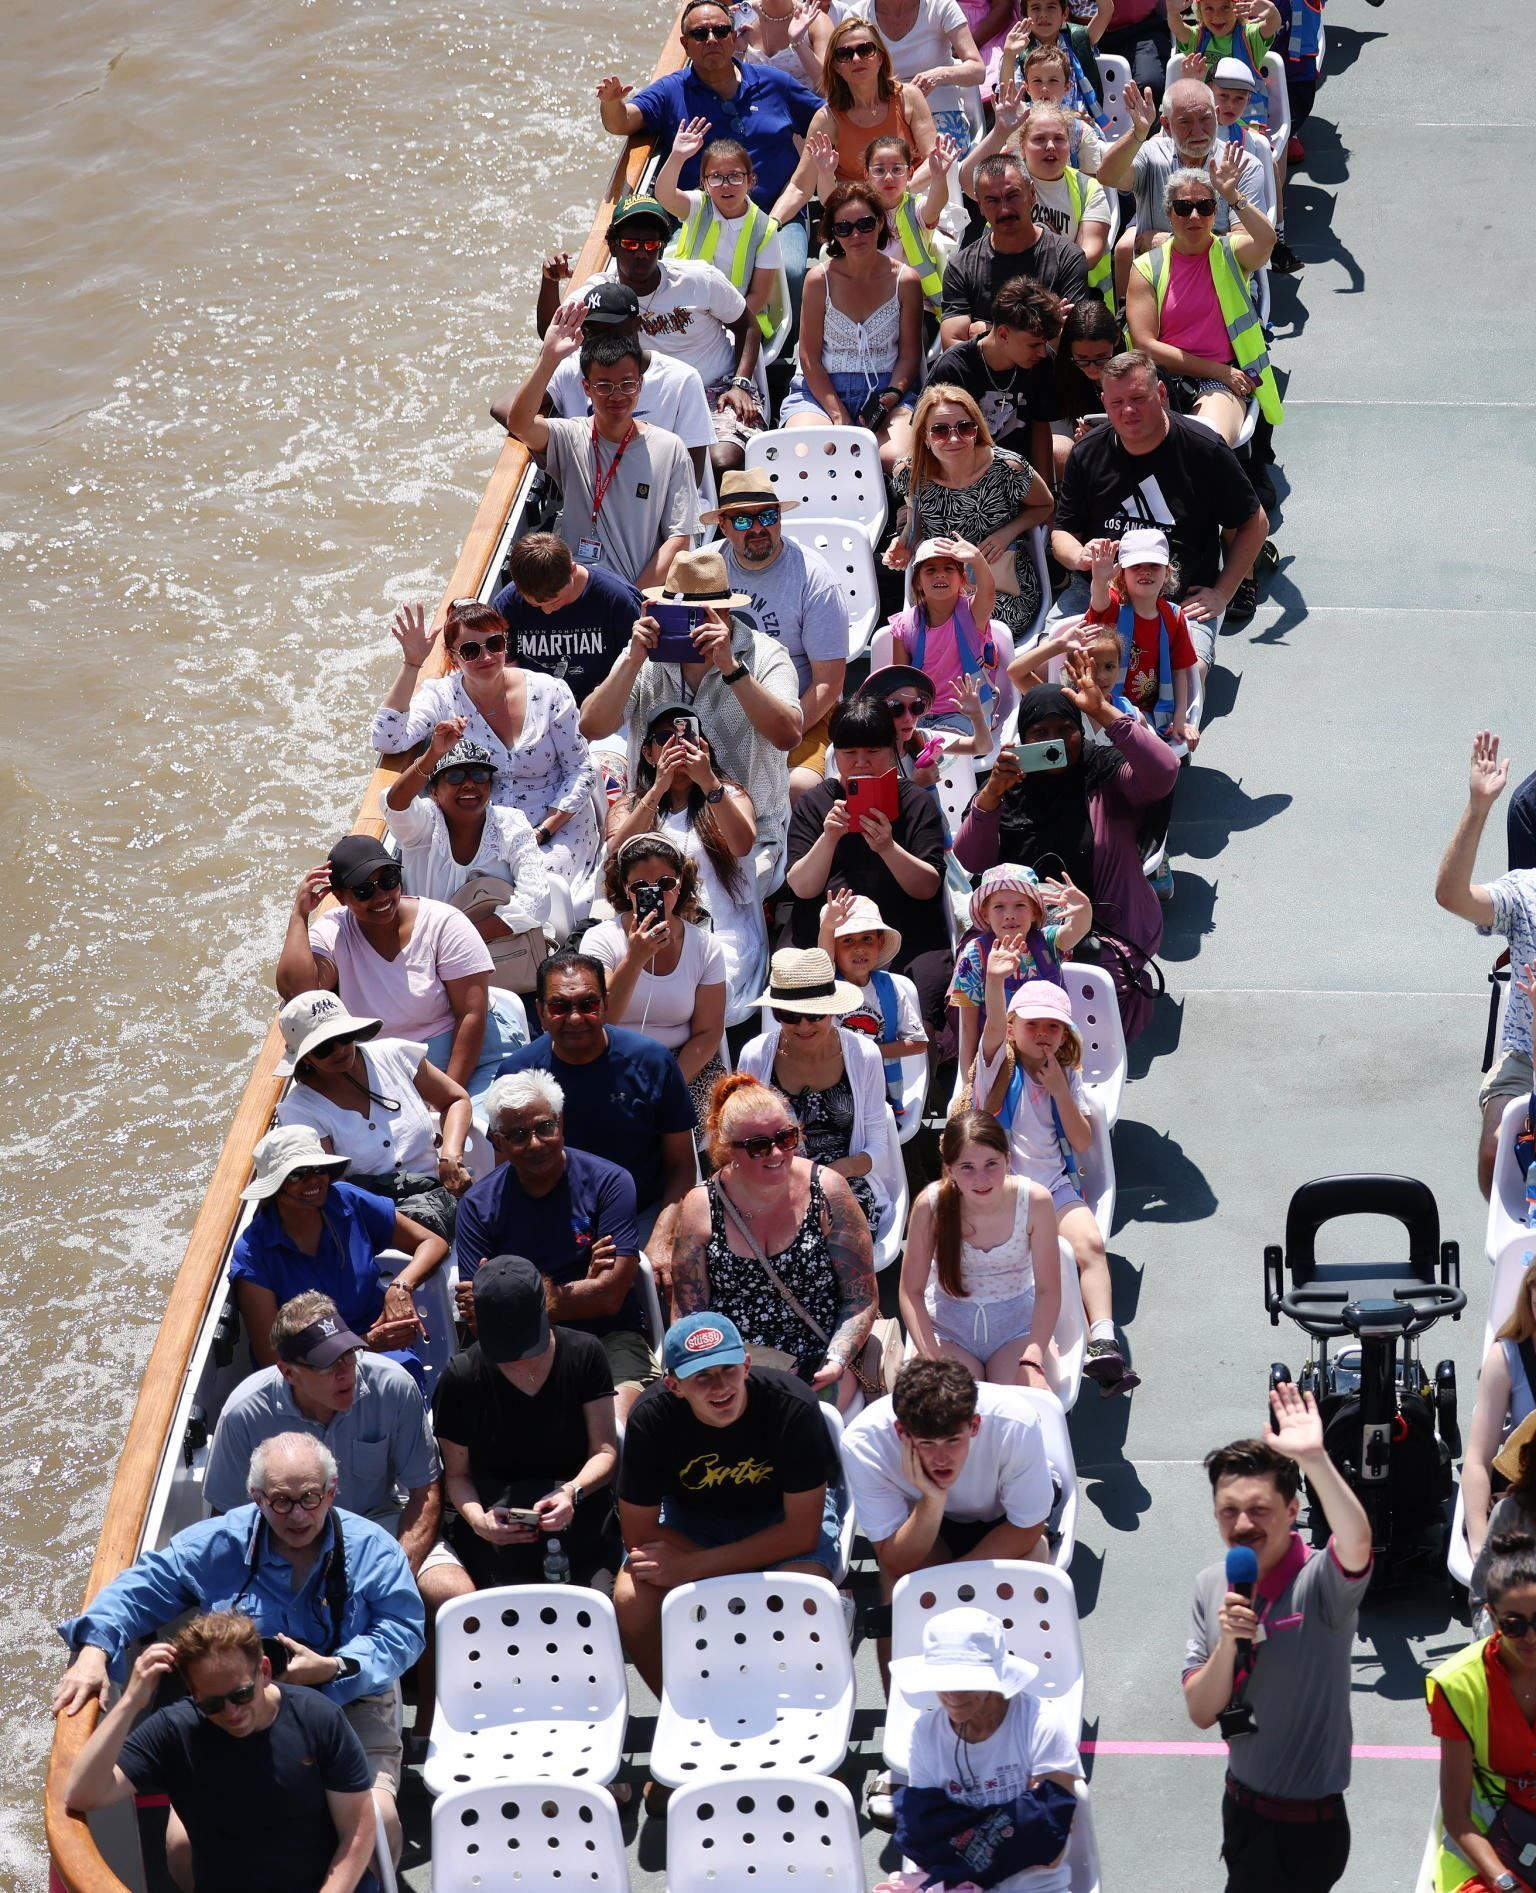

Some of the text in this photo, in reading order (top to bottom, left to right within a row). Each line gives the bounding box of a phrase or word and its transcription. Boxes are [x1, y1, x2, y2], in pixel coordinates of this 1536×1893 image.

[1031, 203, 1070, 235] OCONUT
[1104, 518, 1121, 531] LOS
[731, 588, 781, 637] THAN EZR
[522, 632, 603, 656] MARTIAN
